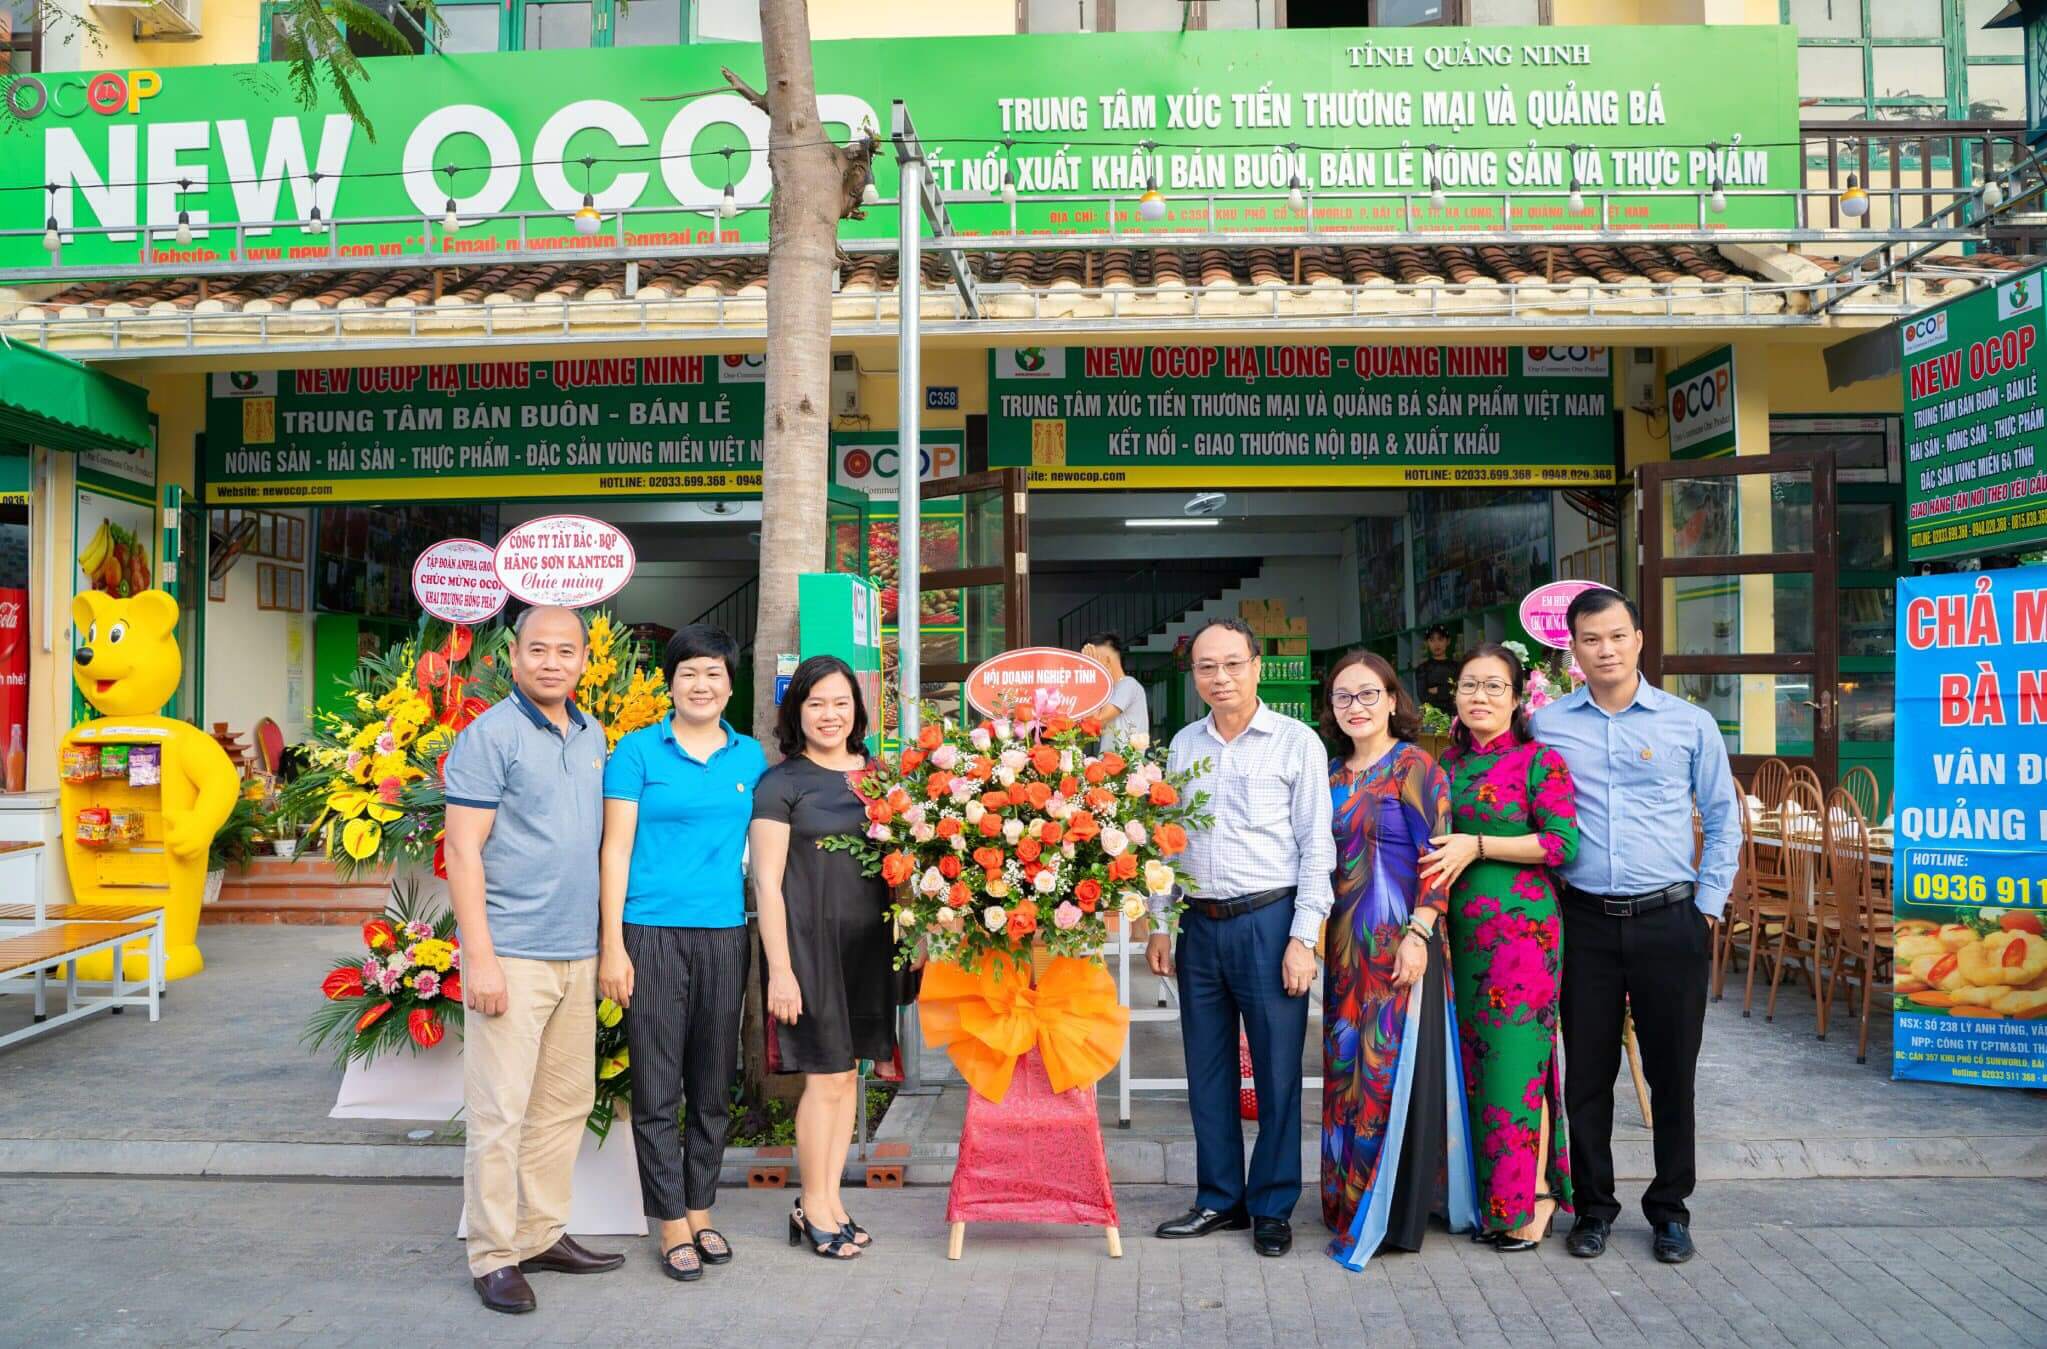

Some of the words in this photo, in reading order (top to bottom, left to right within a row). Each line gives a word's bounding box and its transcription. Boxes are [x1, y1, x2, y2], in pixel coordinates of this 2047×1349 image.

[1345, 38, 1414, 67] TỈNH
[1423, 38, 1514, 70] QUẢNG
[1521, 43, 1592, 66] NINH
[8, 70, 163, 119] OCOP
[998, 95, 1088, 132] TRUNG
[1098, 88, 1157, 130] TÂM
[1166, 87, 1222, 130] XÚC
[1231, 80, 1292, 129] TIẾN
[1302, 88, 1412, 128] THƯƠNG
[1422, 91, 1475, 132] MẠI
[1484, 84, 1518, 126] VÀ
[1527, 80, 1620, 126] QUẢNG
[1629, 82, 1667, 126] BÁ
[45, 113, 355, 245] NEW
[962, 145, 1007, 192] NỐI
[1016, 144, 1082, 190] XUẤT
[1171, 148, 1227, 189] BÁN
[1320, 144, 1376, 188] BÁN
[1384, 140, 1413, 187] LẺ
[1422, 147, 1497, 187] NÔNG
[1506, 139, 1558, 186] SẢN
[1611, 148, 1680, 191] THỰC
[1688, 133, 1768, 186] PHẨM
[1905, 313, 1945, 342] OCOP
[296, 366, 351, 395] NEW
[357, 364, 422, 393] OCOP
[427, 363, 462, 398] HẠ
[467, 360, 531, 391] LONG
[642, 354, 704, 385] NINH
[1085, 346, 1145, 378] NEW
[1151, 346, 1218, 378] OCOP
[1224, 346, 1260, 384] HẠ
[1266, 346, 1332, 378] LONG
[1446, 345, 1509, 377] NINH
[1910, 348, 1963, 400] NEW
[1969, 324, 2036, 382] OCOP
[282, 410, 374, 433] TRUNG
[383, 403, 443, 431] TÂM
[453, 402, 511, 429] BÁN
[520, 400, 600, 428] BUÔN
[629, 398, 689, 425] BÁN
[700, 393, 731, 424] LẺ
[928, 390, 957, 407] C358
[1000, 394, 1059, 417] TRUNG
[1064, 390, 1101, 417] TÂM
[1107, 390, 1142, 417] XÚC
[1147, 386, 1186, 417] TIẾN
[1191, 392, 1261, 417] THƯƠNG
[1266, 394, 1300, 421] MẠI
[1305, 389, 1328, 416] VÀ
[1333, 386, 1393, 418] QUẢNG
[1399, 389, 1422, 416] BÁ
[1426, 386, 1463, 416] SẢN
[1467, 384, 1519, 416] PHẨM
[1523, 388, 1562, 421] VIỆT
[1564, 393, 1605, 416] NAM
[1672, 368, 1729, 423] OCOP
[1913, 407, 1938, 429] TRUNG
[1939, 399, 1956, 418] TÂM
[1957, 395, 1975, 416] BÁN
[1975, 385, 1999, 410] BUÔN
[2006, 377, 2025, 402] BÁN
[1108, 425, 1141, 456] KẾT
[1146, 425, 1176, 456] NỐI
[1194, 432, 1235, 456] GIAO
[1240, 431, 1310, 456] THƯƠNG
[1314, 427, 1345, 460] NỘI
[1349, 431, 1380, 460] ĐỊA
[1386, 432, 1399, 456] &
[1404, 424, 1449, 456] XUẤT
[1453, 423, 1501, 455] KHẨU
[1910, 437, 1923, 462] HẢI
[1924, 433, 1940, 458] SẢN
[1946, 429, 1969, 453] NÔNG
[1970, 420, 1987, 446] SẢN
[1994, 414, 2017, 440] THỰC
[2018, 402, 2045, 434] PHẨM
[225, 446, 271, 474] NÔNG
[277, 442, 311, 473] SẢN
[327, 441, 355, 472] HẢI
[360, 440, 395, 471] SẢN
[411, 444, 454, 474] THỰC
[459, 435, 509, 469] PHẨM
[526, 439, 561, 472] ĐẶC
[566, 435, 601, 466] SẢN
[606, 436, 652, 465] VÙNG
[708, 435, 745, 468] VIỆT
[1920, 468, 1936, 493] ĐẶC
[1937, 461, 1953, 487] SẢN
[1954, 457, 1976, 482] VÙNG
[2001, 452, 2012, 472] 64
[2013, 442, 2035, 469] TỈNH
[217, 485, 260, 497] Website:
[262, 484, 333, 497] newocop.com
[600, 477, 647, 489] HOTLINE:
[648, 475, 726, 489] 02033.699.368
[1050, 471, 1126, 482] newocop.com
[1404, 469, 1451, 481] HOTLINE:
[1454, 468, 1532, 481] 02033.699.368
[1910, 502, 1928, 520] GIAO
[1928, 495, 1951, 516] HÀNG
[1953, 490, 1969, 514] TẬN
[1987, 483, 2009, 505] THEO
[2010, 476, 2028, 499] YÊU
[509, 531, 536, 549] CÔNG
[538, 534, 550, 549] TY
[599, 533, 618, 550] BQP
[503, 553, 538, 570] HÃNG
[541, 555, 565, 570] SƠN
[567, 554, 625, 569] KANTECH
[420, 573, 446, 585] CHÚC
[447, 574, 477, 588] MỪNG
[425, 591, 439, 604] KHAI
[521, 571, 558, 590] Chúc
[1906, 575, 2001, 650] CHẢ
[983, 668, 1000, 688] HỘI
[1002, 670, 1034, 685] DOANH
[1036, 666, 1072, 687] NGHIỆP
[1075, 665, 1097, 684] TỈNH
[1939, 661, 2006, 727] BÀ
[1933, 746, 2006, 785] VÂN
[1901, 797, 2026, 842] QUẢNG
[1912, 853, 1969, 868] HOTLINE:
[1912, 873, 1987, 902] 0936
[1900, 1017, 1922, 1029] NSX:
[1924, 1016, 1937, 1031] SỐ
[1940, 1021, 1958, 1033] 238
[1975, 1024, 1996, 1034] ANH
[1911, 1036, 1934, 1048] NPP:
[1937, 1036, 1964, 1050] CÔNG
[1967, 1039, 1977, 1050] TY
[1981, 1040, 2030, 1054] CPTM&DL
[1940, 1053, 1955, 1063] KHU
[1952, 1067, 1979, 1079] Hotline:
[2006, 1071, 2019, 1081] 511
